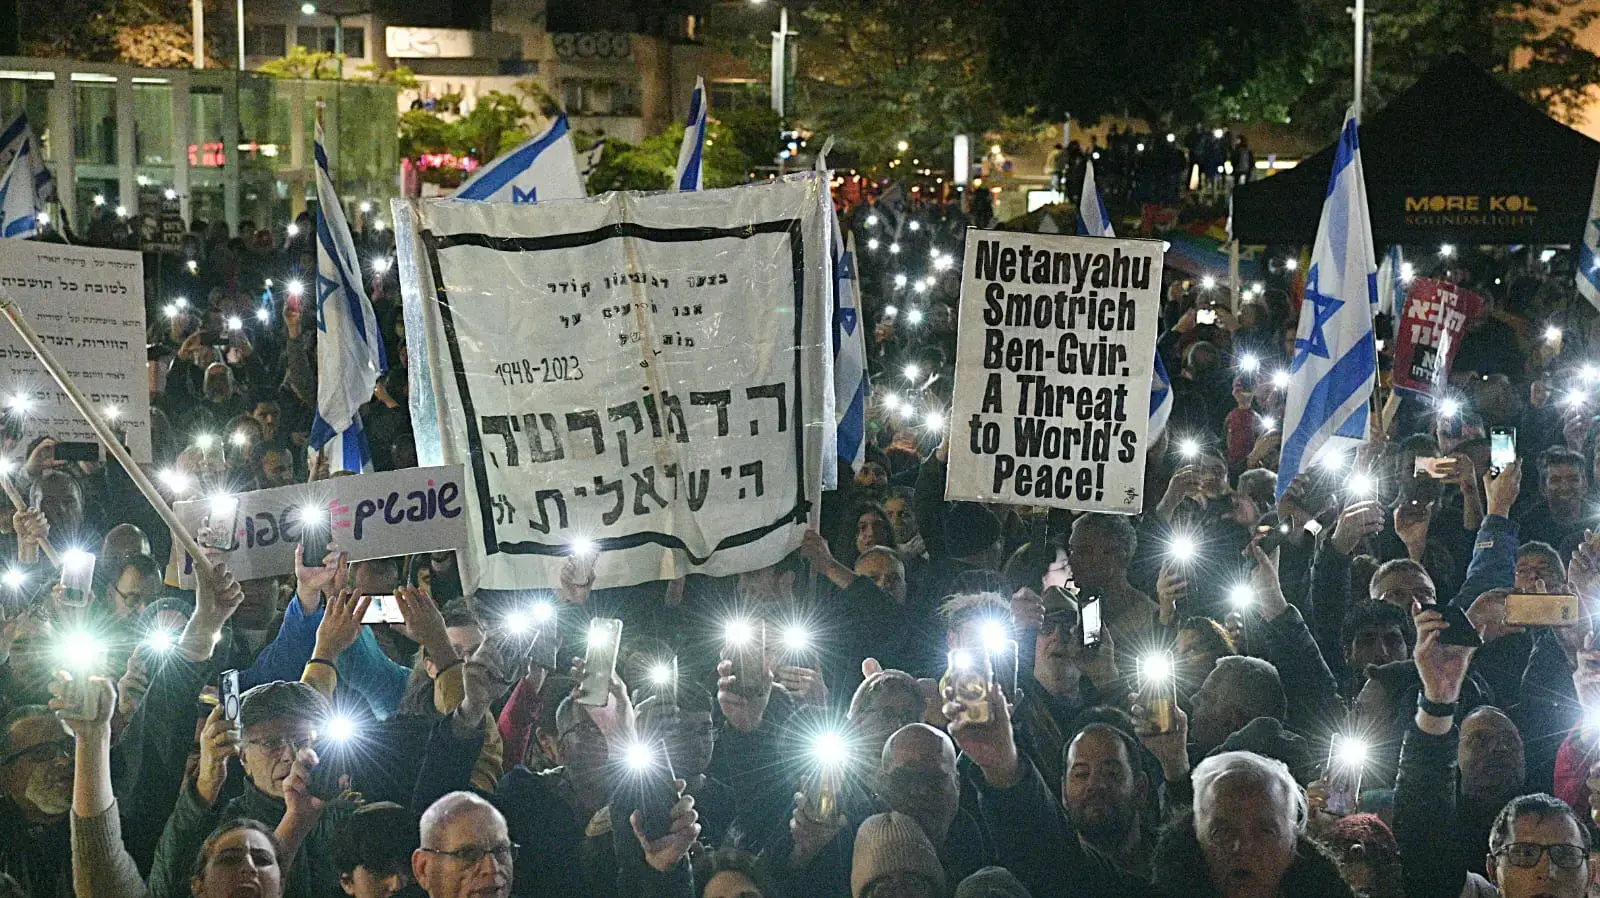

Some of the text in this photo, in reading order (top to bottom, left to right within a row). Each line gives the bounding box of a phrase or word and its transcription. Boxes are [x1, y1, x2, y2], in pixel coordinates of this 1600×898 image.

[1405, 196, 1538, 212] MORE KOL
[2, 275, 128, 295] לטובת כל תושביה
[547, 278, 591, 298] קודר
[975, 239, 1152, 294] Netanyahu
[983, 283, 1136, 331] Smotrich
[495, 355, 585, 386] 1948-2023
[983, 328, 1130, 377] Ben-Gvir.
[982, 373, 1128, 422] A Threat
[969, 414, 1138, 463] to World's
[992, 454, 1106, 501] Peace!
